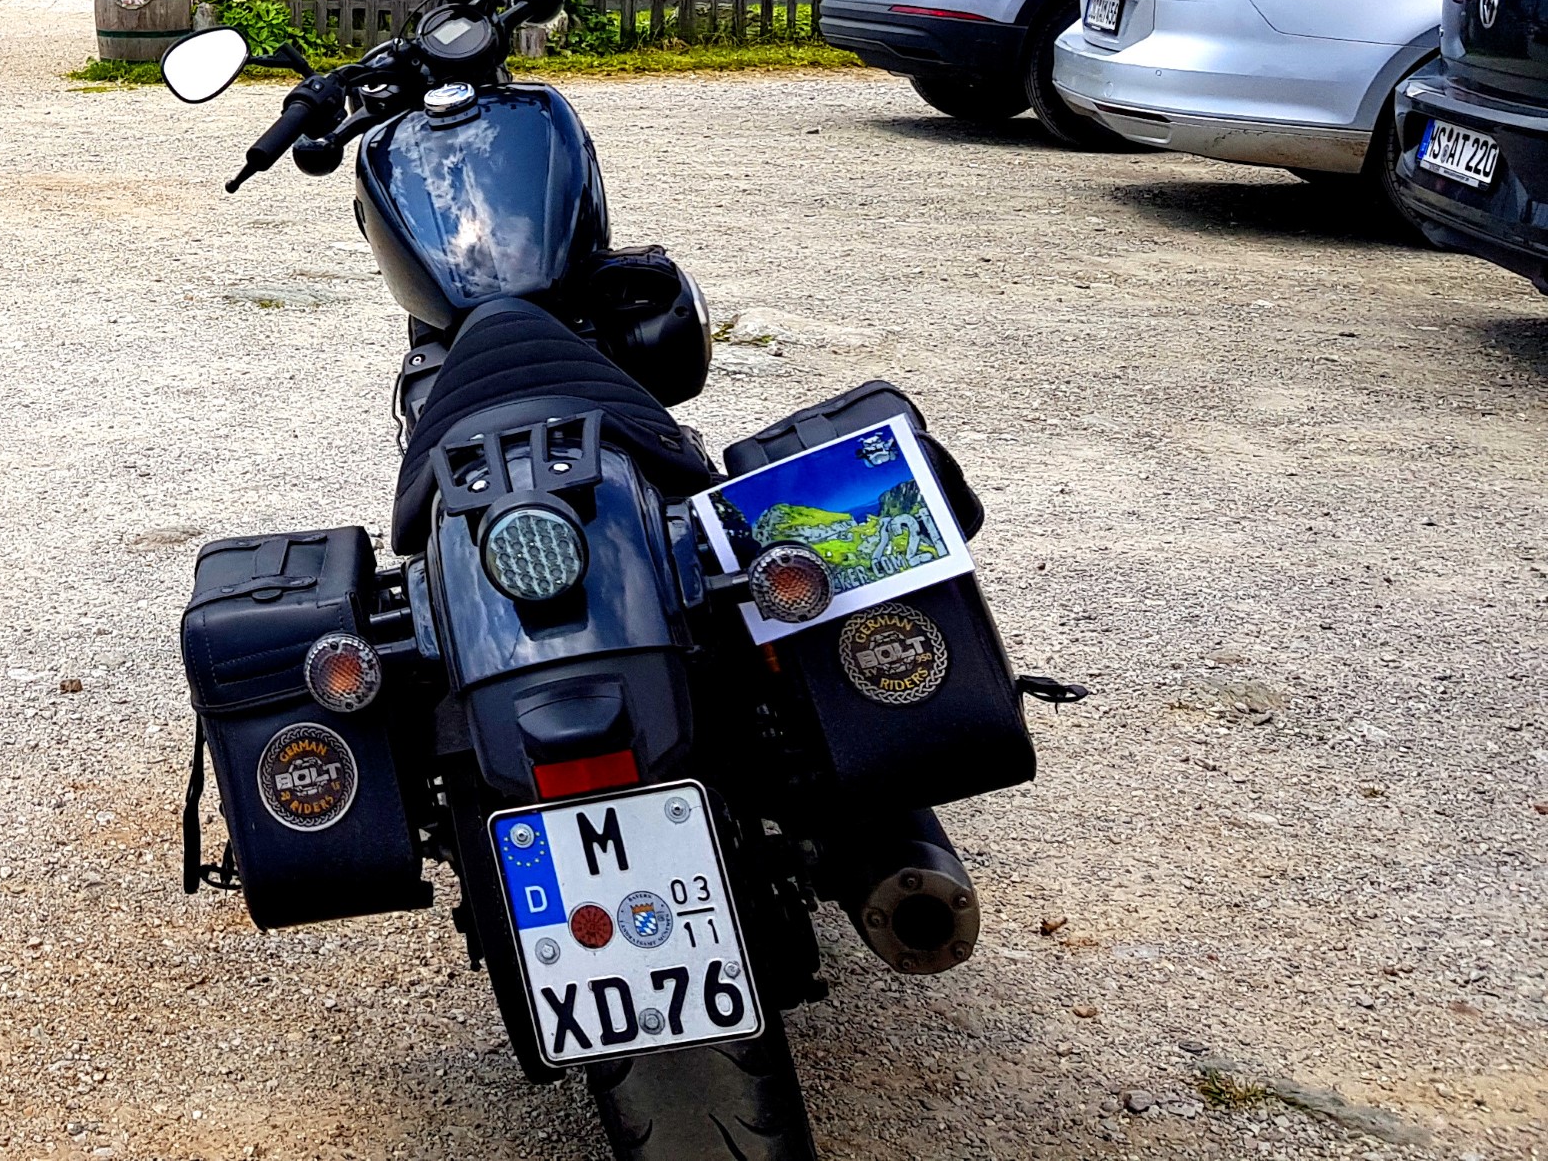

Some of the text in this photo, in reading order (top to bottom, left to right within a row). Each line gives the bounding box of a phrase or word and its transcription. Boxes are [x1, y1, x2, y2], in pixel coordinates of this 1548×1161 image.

[1446, 132, 1470, 167] AT
[1465, 138, 1498, 178] 220
[855, 615, 914, 643] GERMAN
[856, 636, 926, 669] BOLT
[879, 667, 929, 691] RIDERS
[279, 739, 328, 762] GERMAN
[275, 762, 341, 790] BOLT
[290, 794, 334, 814] RIDERS
[575, 807, 630, 876] M
[525, 885, 548, 914] D
[670, 875, 711, 905] 03
[683, 918, 720, 948] 11
[540, 959, 745, 1054] XD 76
